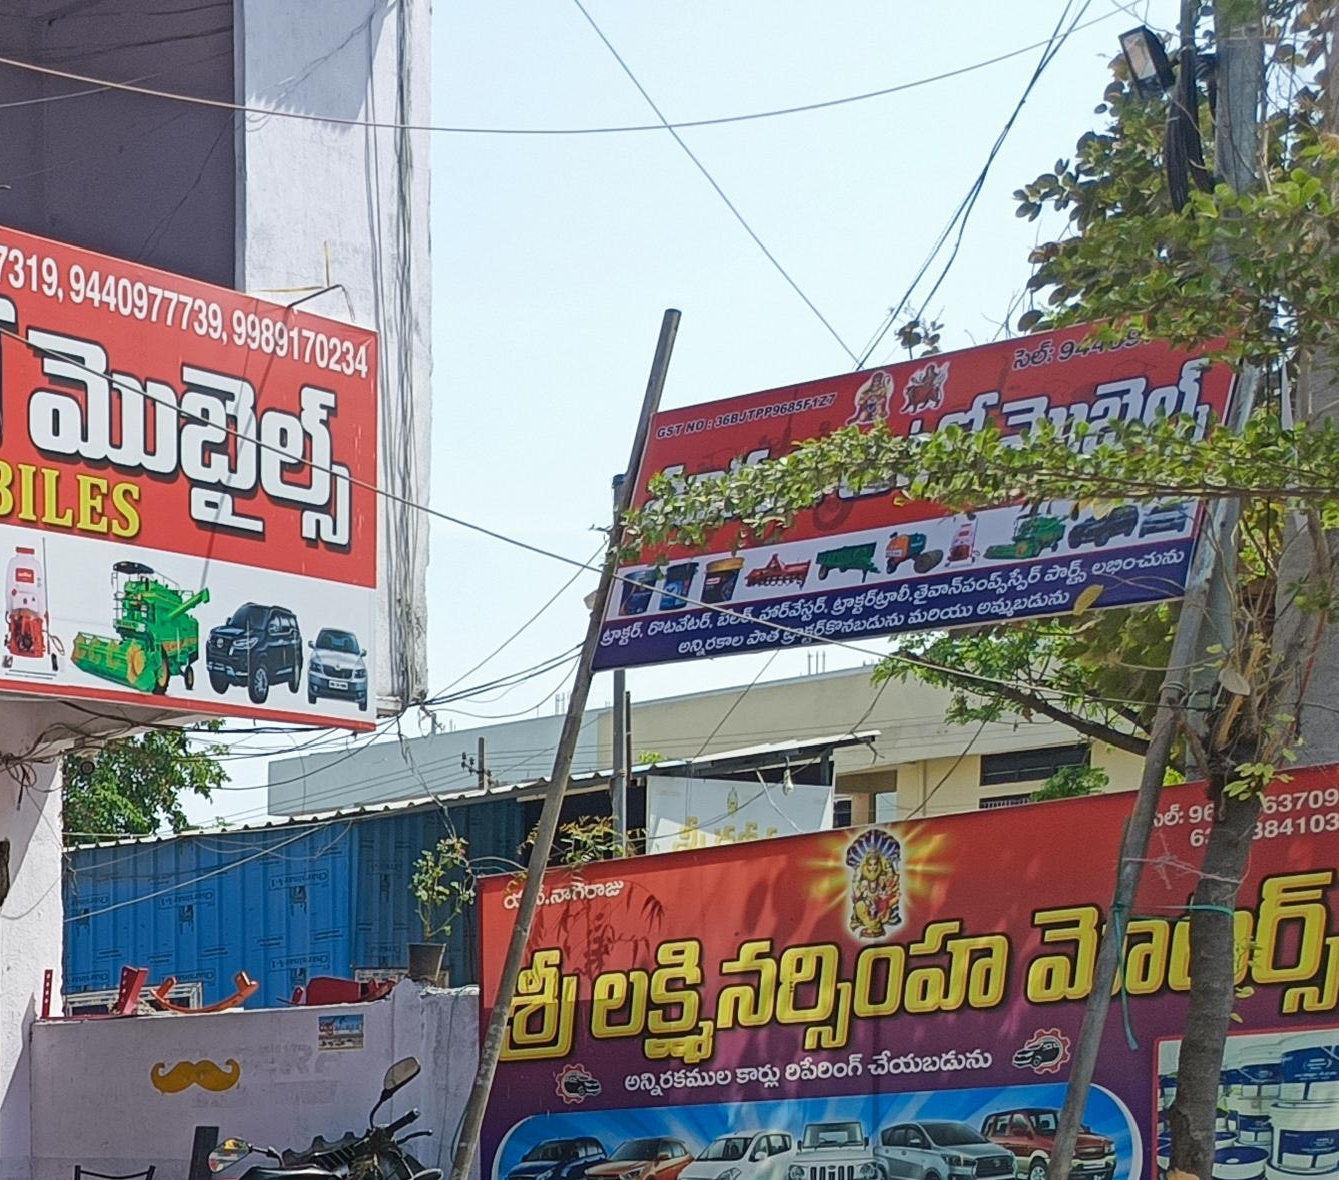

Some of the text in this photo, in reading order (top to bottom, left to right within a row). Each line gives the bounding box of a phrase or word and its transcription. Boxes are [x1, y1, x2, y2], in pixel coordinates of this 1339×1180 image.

[69, 264, 228, 346] 9440977739,
[232, 307, 368, 379] 9989170234
[25, 326, 353, 548] మొబైల్స్
[656, 425, 682, 439] GST
[686, 420, 704, 433] NO
[500, 948, 578, 1063] శ్రీ
